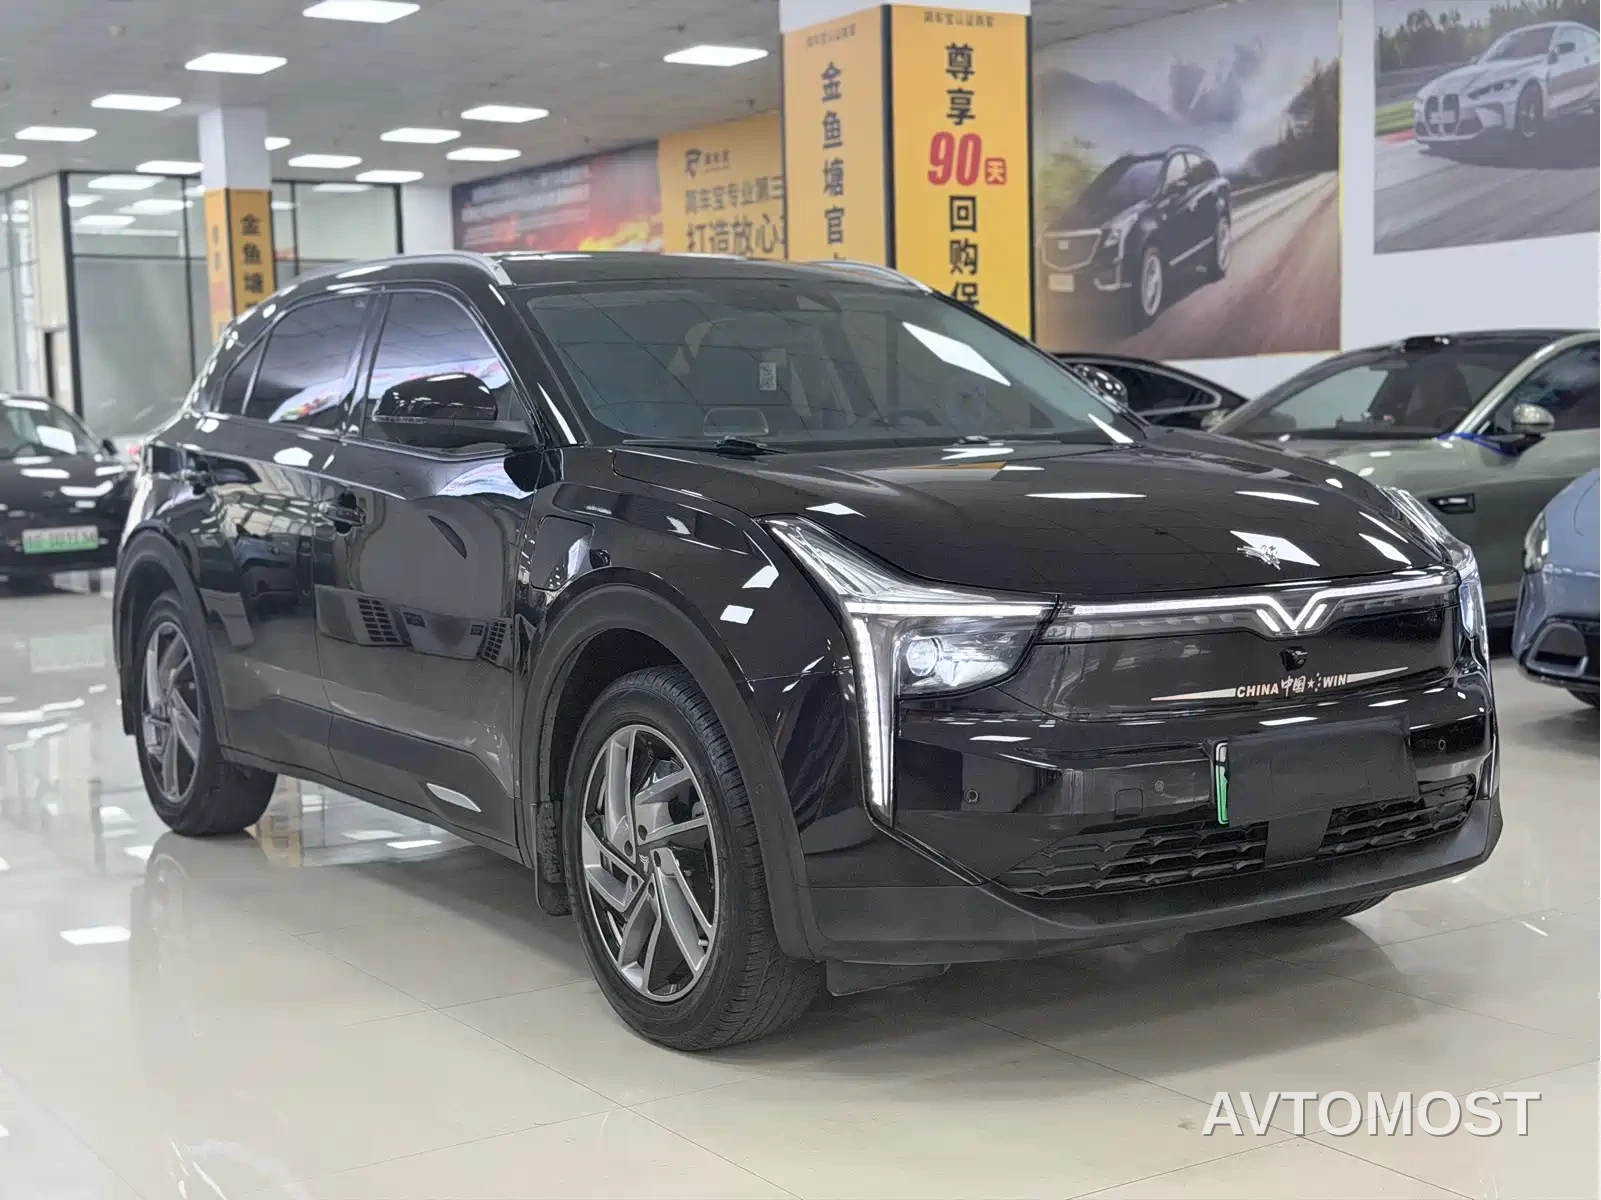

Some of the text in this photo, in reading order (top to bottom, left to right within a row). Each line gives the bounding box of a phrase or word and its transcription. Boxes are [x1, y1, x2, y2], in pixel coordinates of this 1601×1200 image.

[945, 42, 976, 126] 尊享
[820, 61, 846, 262] 金鱼塘官
[927, 131, 1007, 187] 90天
[241, 213, 264, 308] 金鱼塘
[686, 212, 786, 256] 打造放心
[1236, 673, 1347, 698] CHINA 中国 WIN
